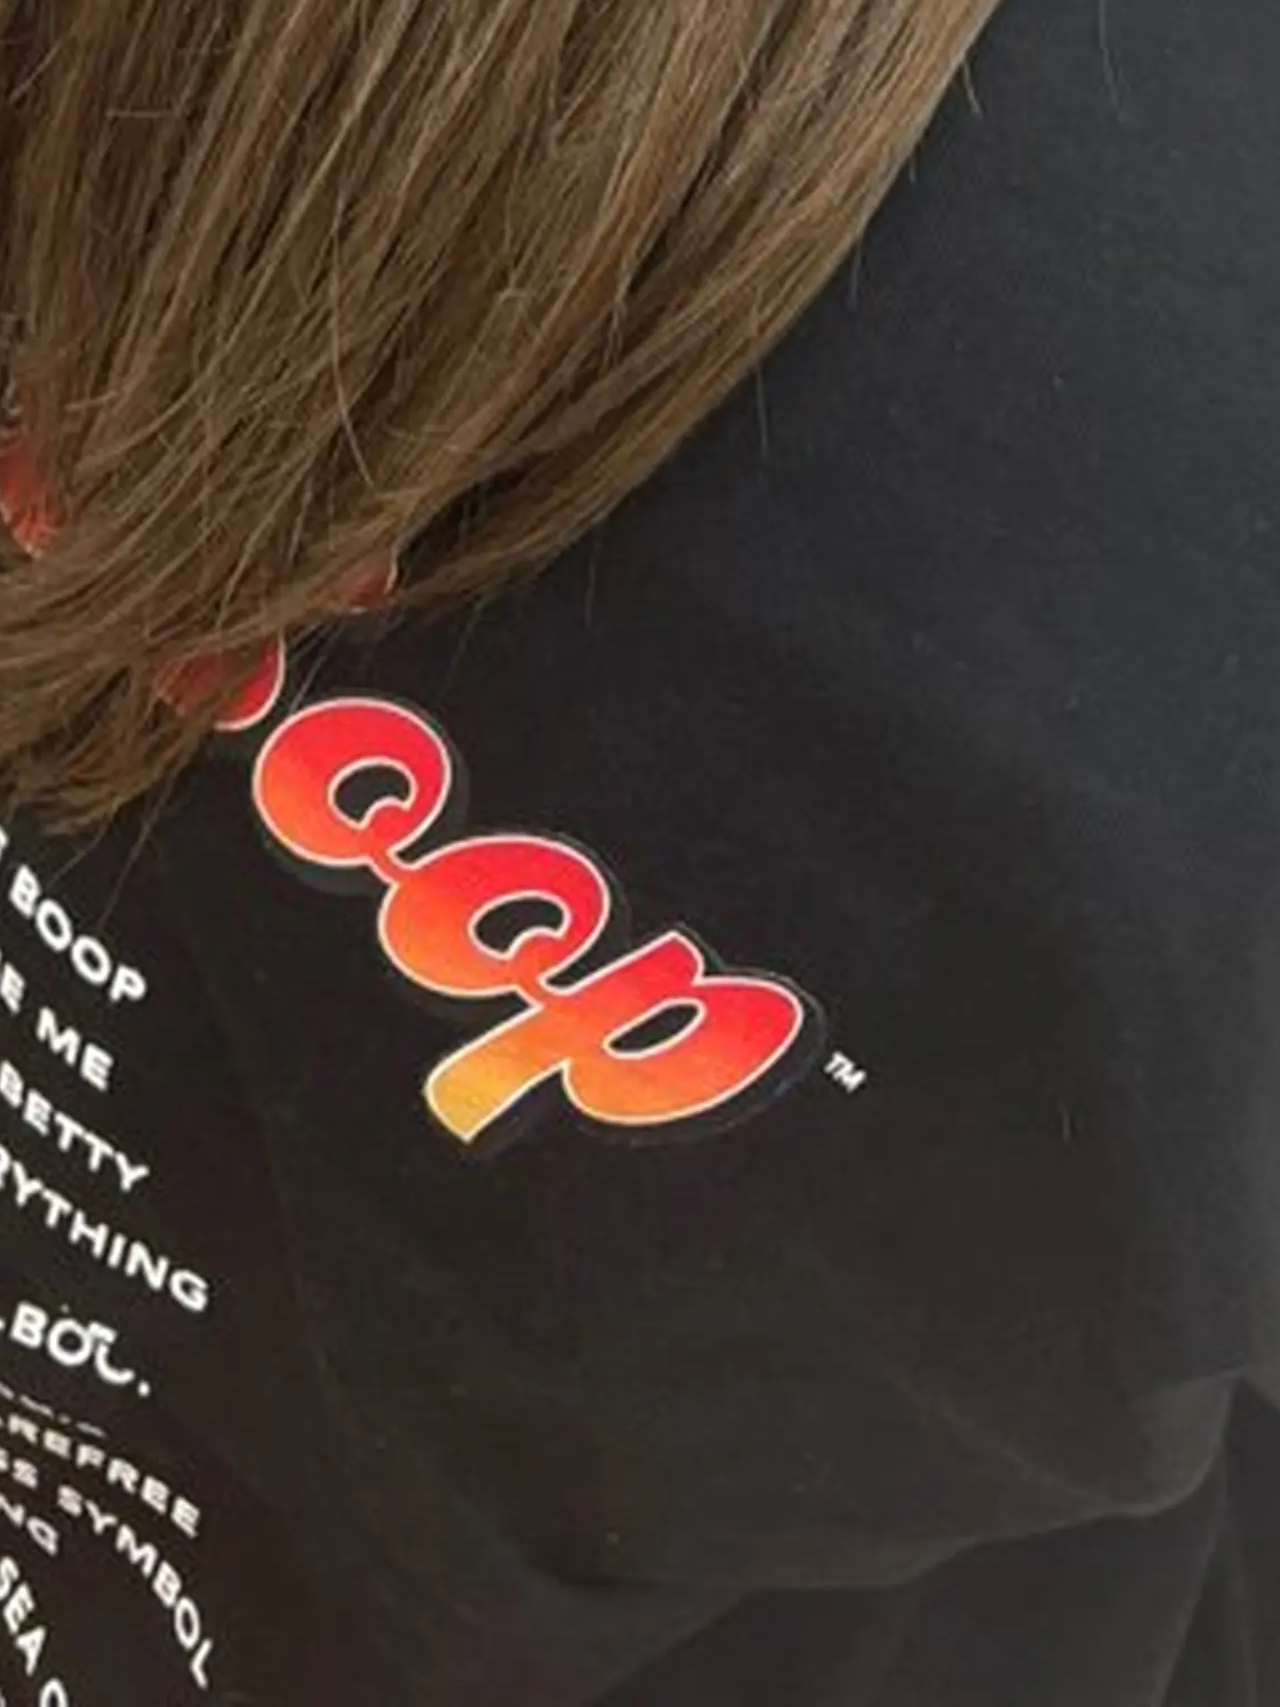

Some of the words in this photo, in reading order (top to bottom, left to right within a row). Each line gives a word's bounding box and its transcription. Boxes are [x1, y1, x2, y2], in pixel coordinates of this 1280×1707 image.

[8, 864, 148, 1003] BOOP
[35, 1006, 114, 1091] ME
[55, 1483, 213, 1691] SYMBOL
